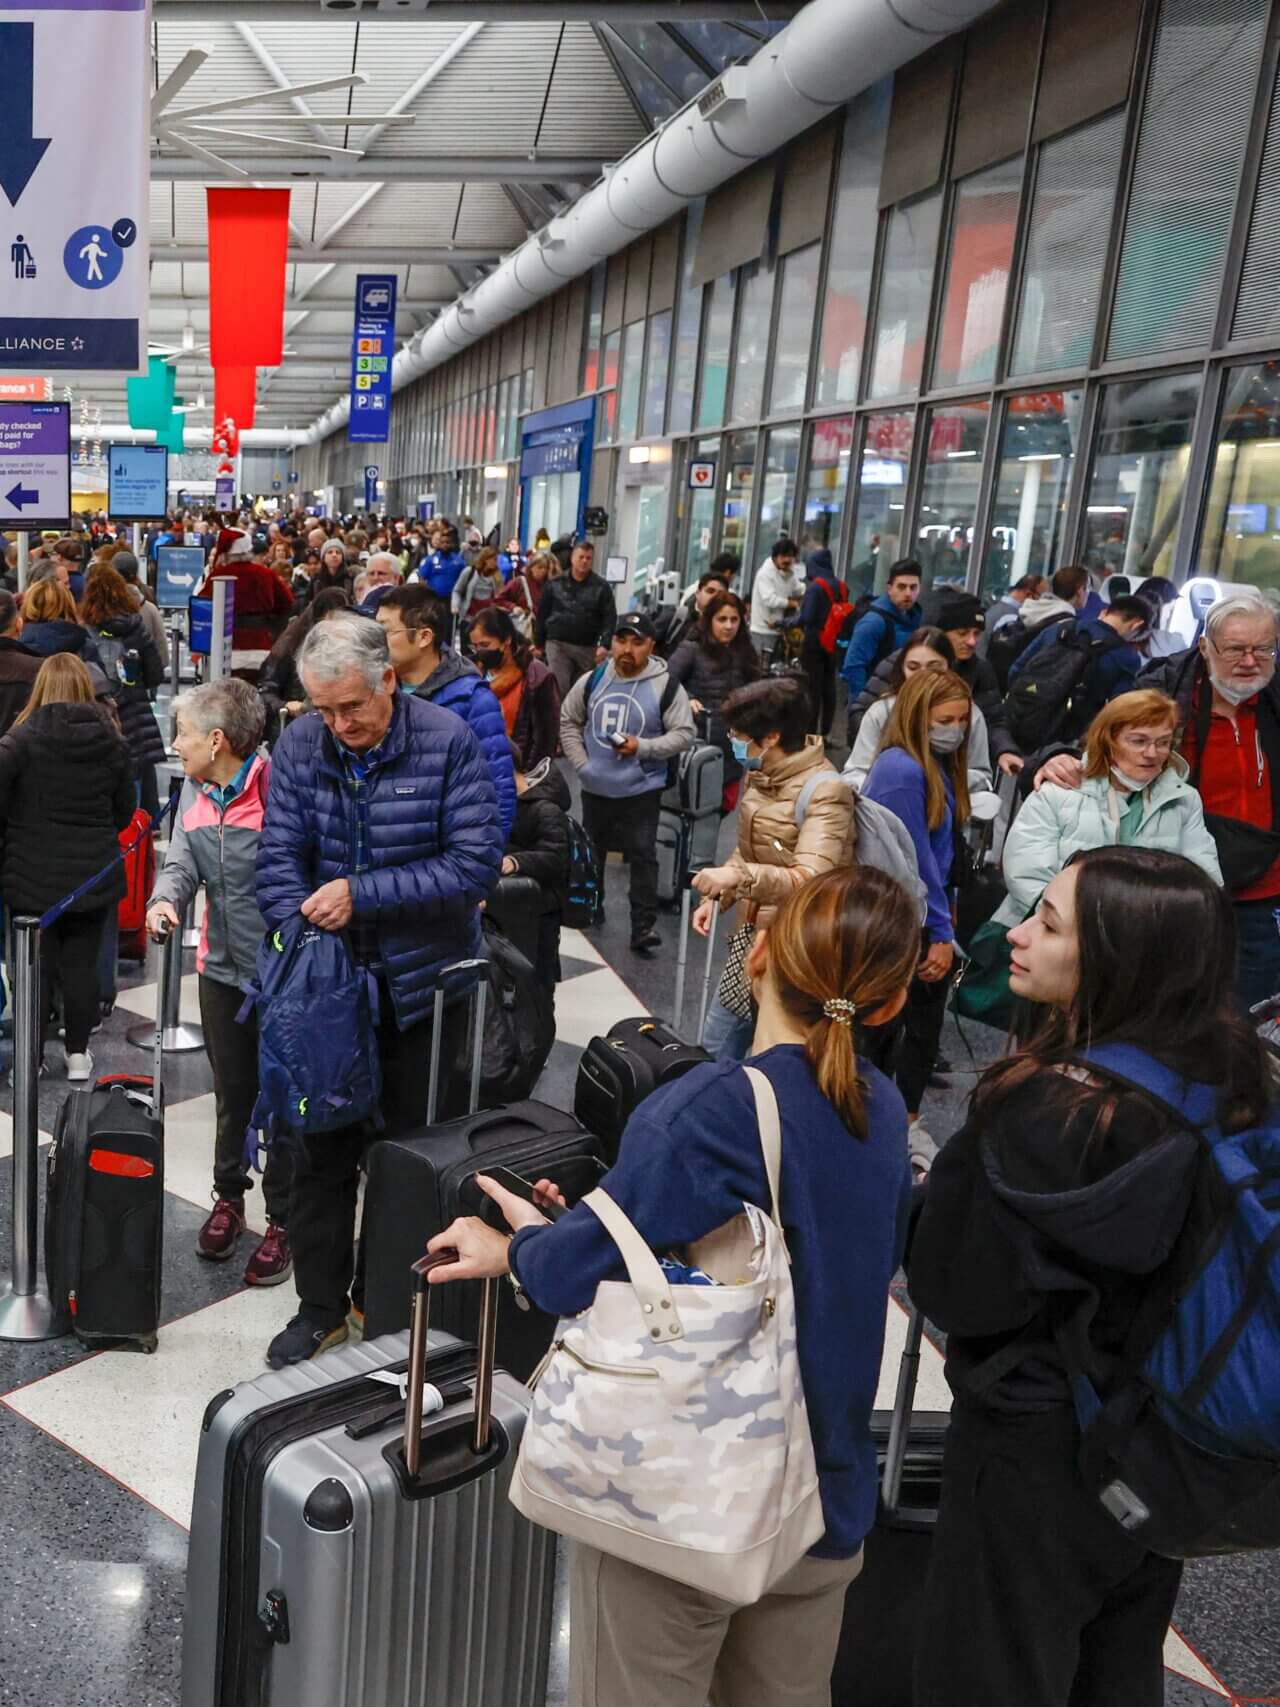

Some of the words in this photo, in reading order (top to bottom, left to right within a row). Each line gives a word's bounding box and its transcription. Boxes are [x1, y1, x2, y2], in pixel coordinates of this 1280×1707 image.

[361, 340, 370, 351] 2
[360, 358, 368, 369] 3
[360, 376, 368, 387] 5
[358, 395, 367, 408] P
[10, 422, 42, 430] checked
[4, 432, 21, 441] paid
[0, 441, 21, 450] bags?
